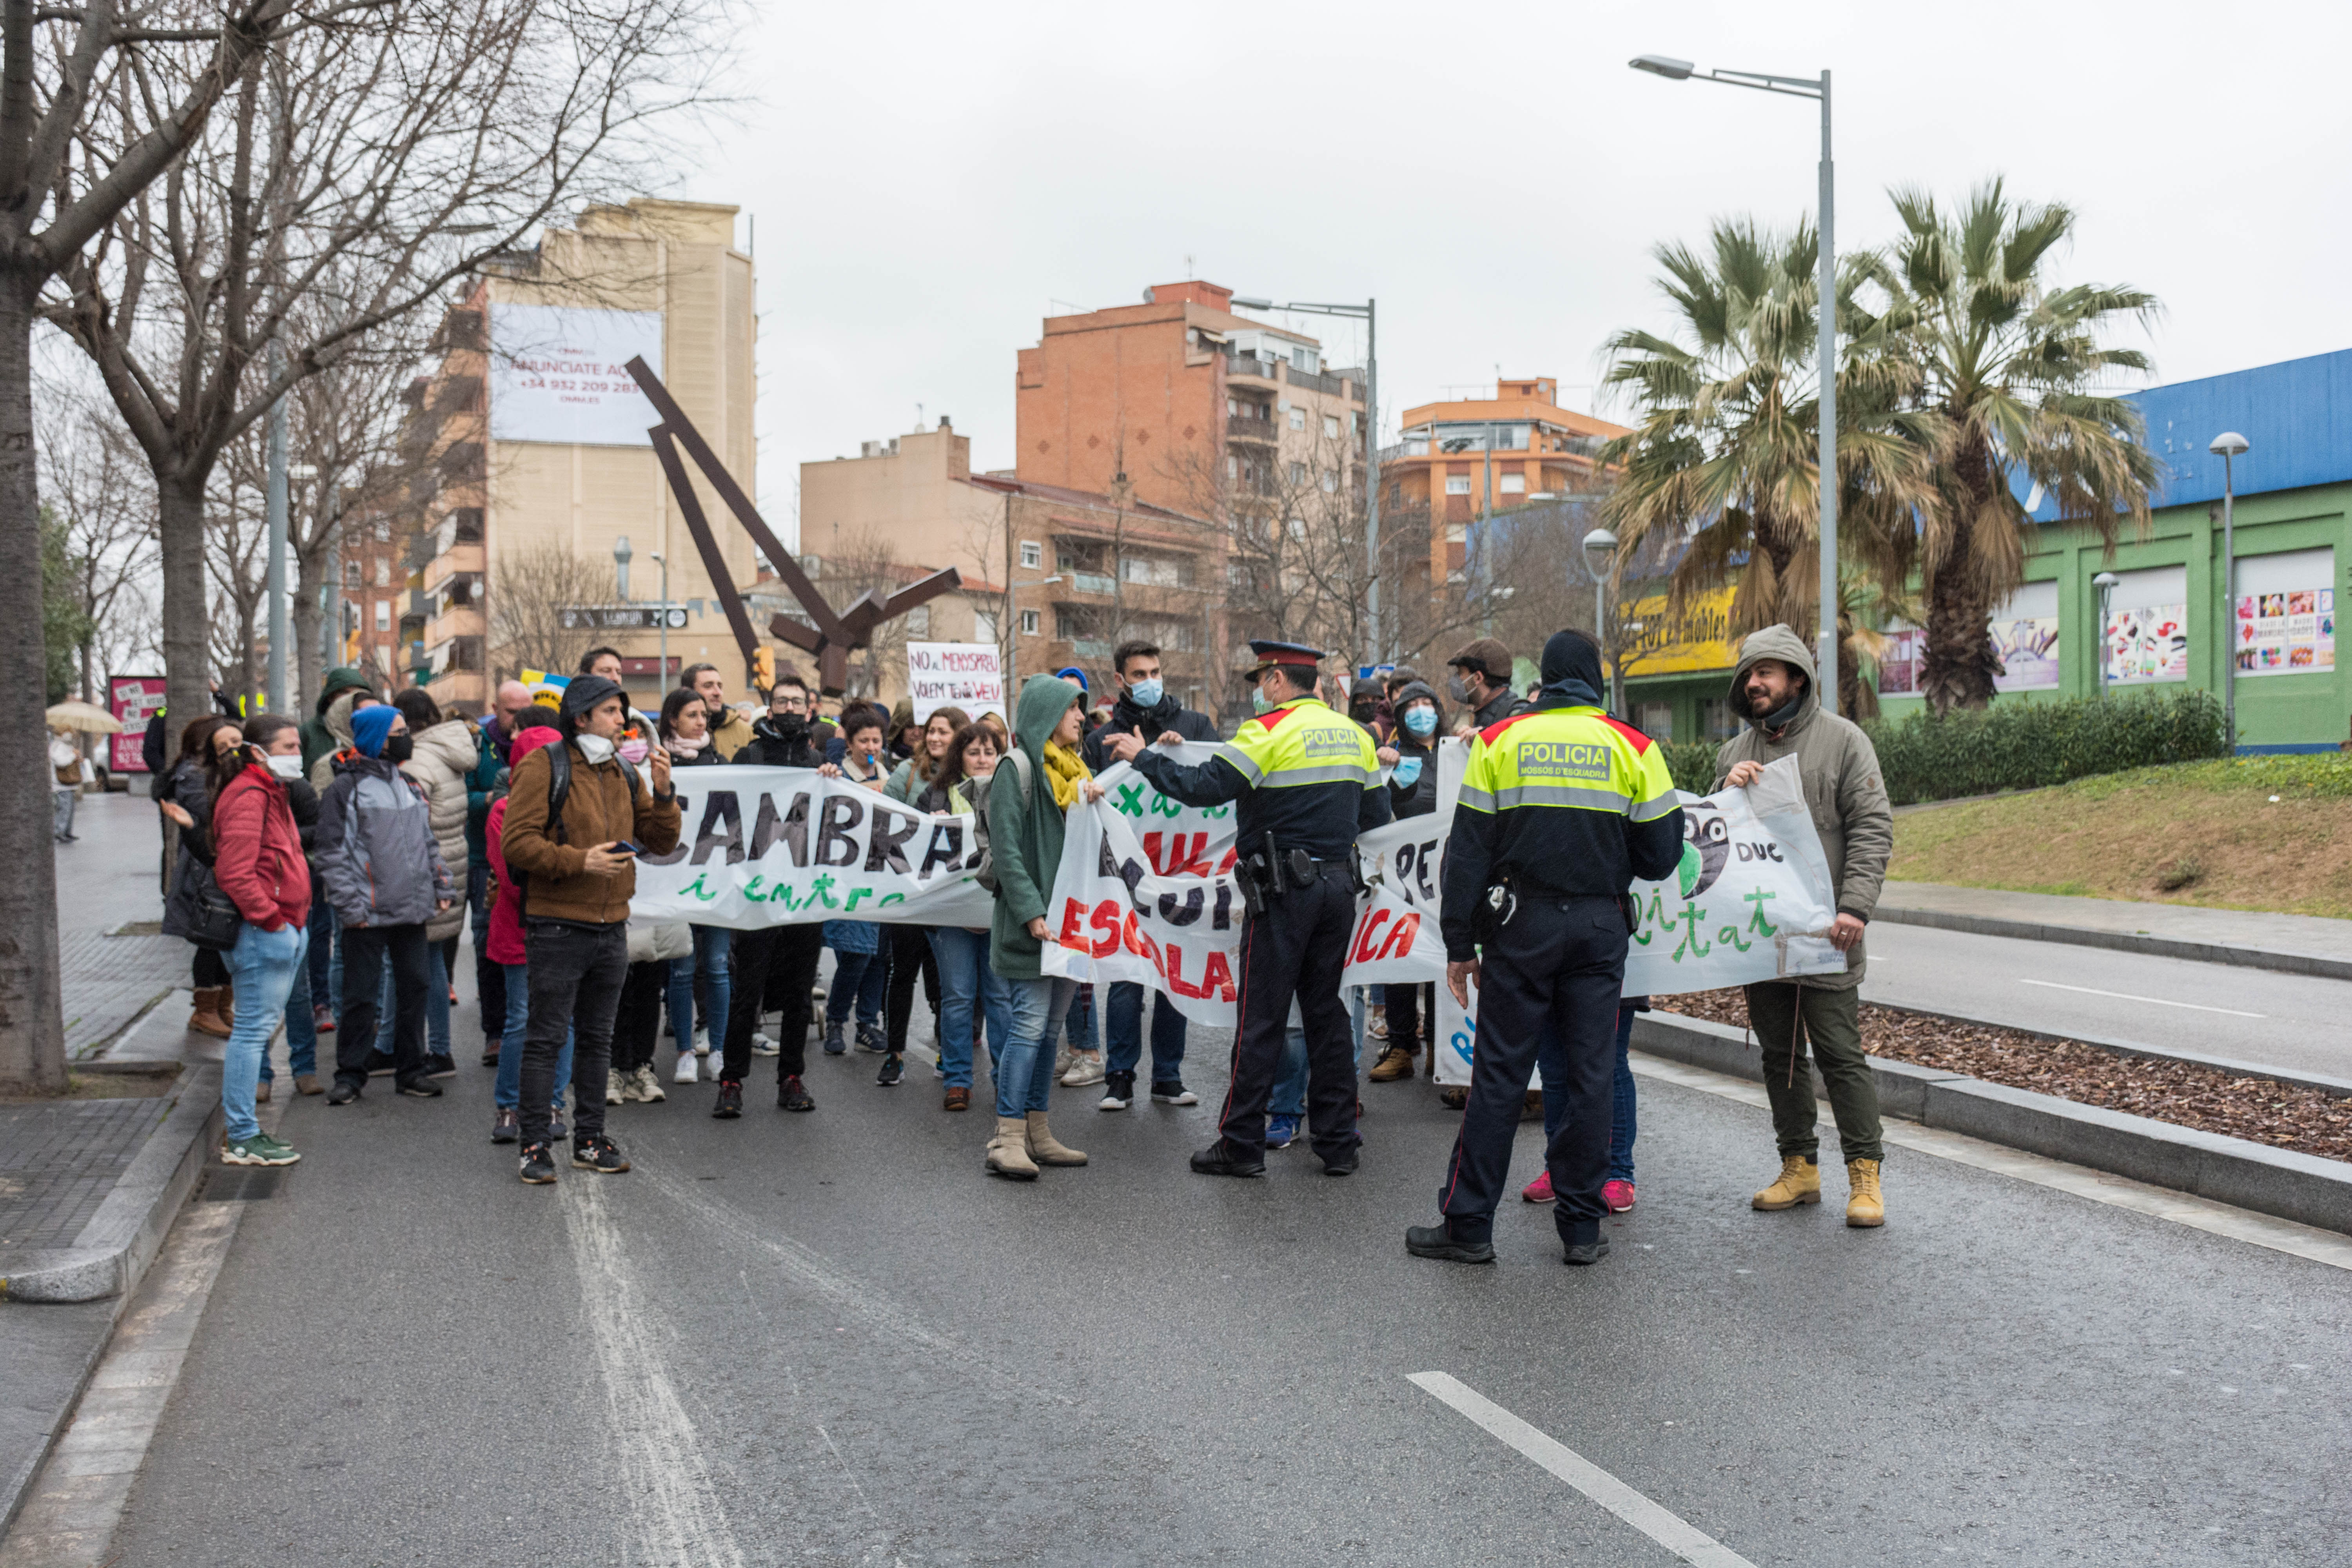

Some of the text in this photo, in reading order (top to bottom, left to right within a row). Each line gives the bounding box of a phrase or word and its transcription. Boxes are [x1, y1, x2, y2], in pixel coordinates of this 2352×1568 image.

[607, 365, 629, 378] AQ
[521, 379, 639, 394] +34 932 209 283
[911, 651, 929, 670] NO
[913, 681, 945, 699] VOLEM
[973, 681, 1000, 700] VEU
[1304, 730, 1359, 746] POLICIA
[1520, 744, 1606, 766] POLICIA
[1521, 766, 1606, 779] MOSSOS D'ESQUADRA
[1735, 842, 1784, 862] DUC
[1342, 904, 1421, 970] ICA
